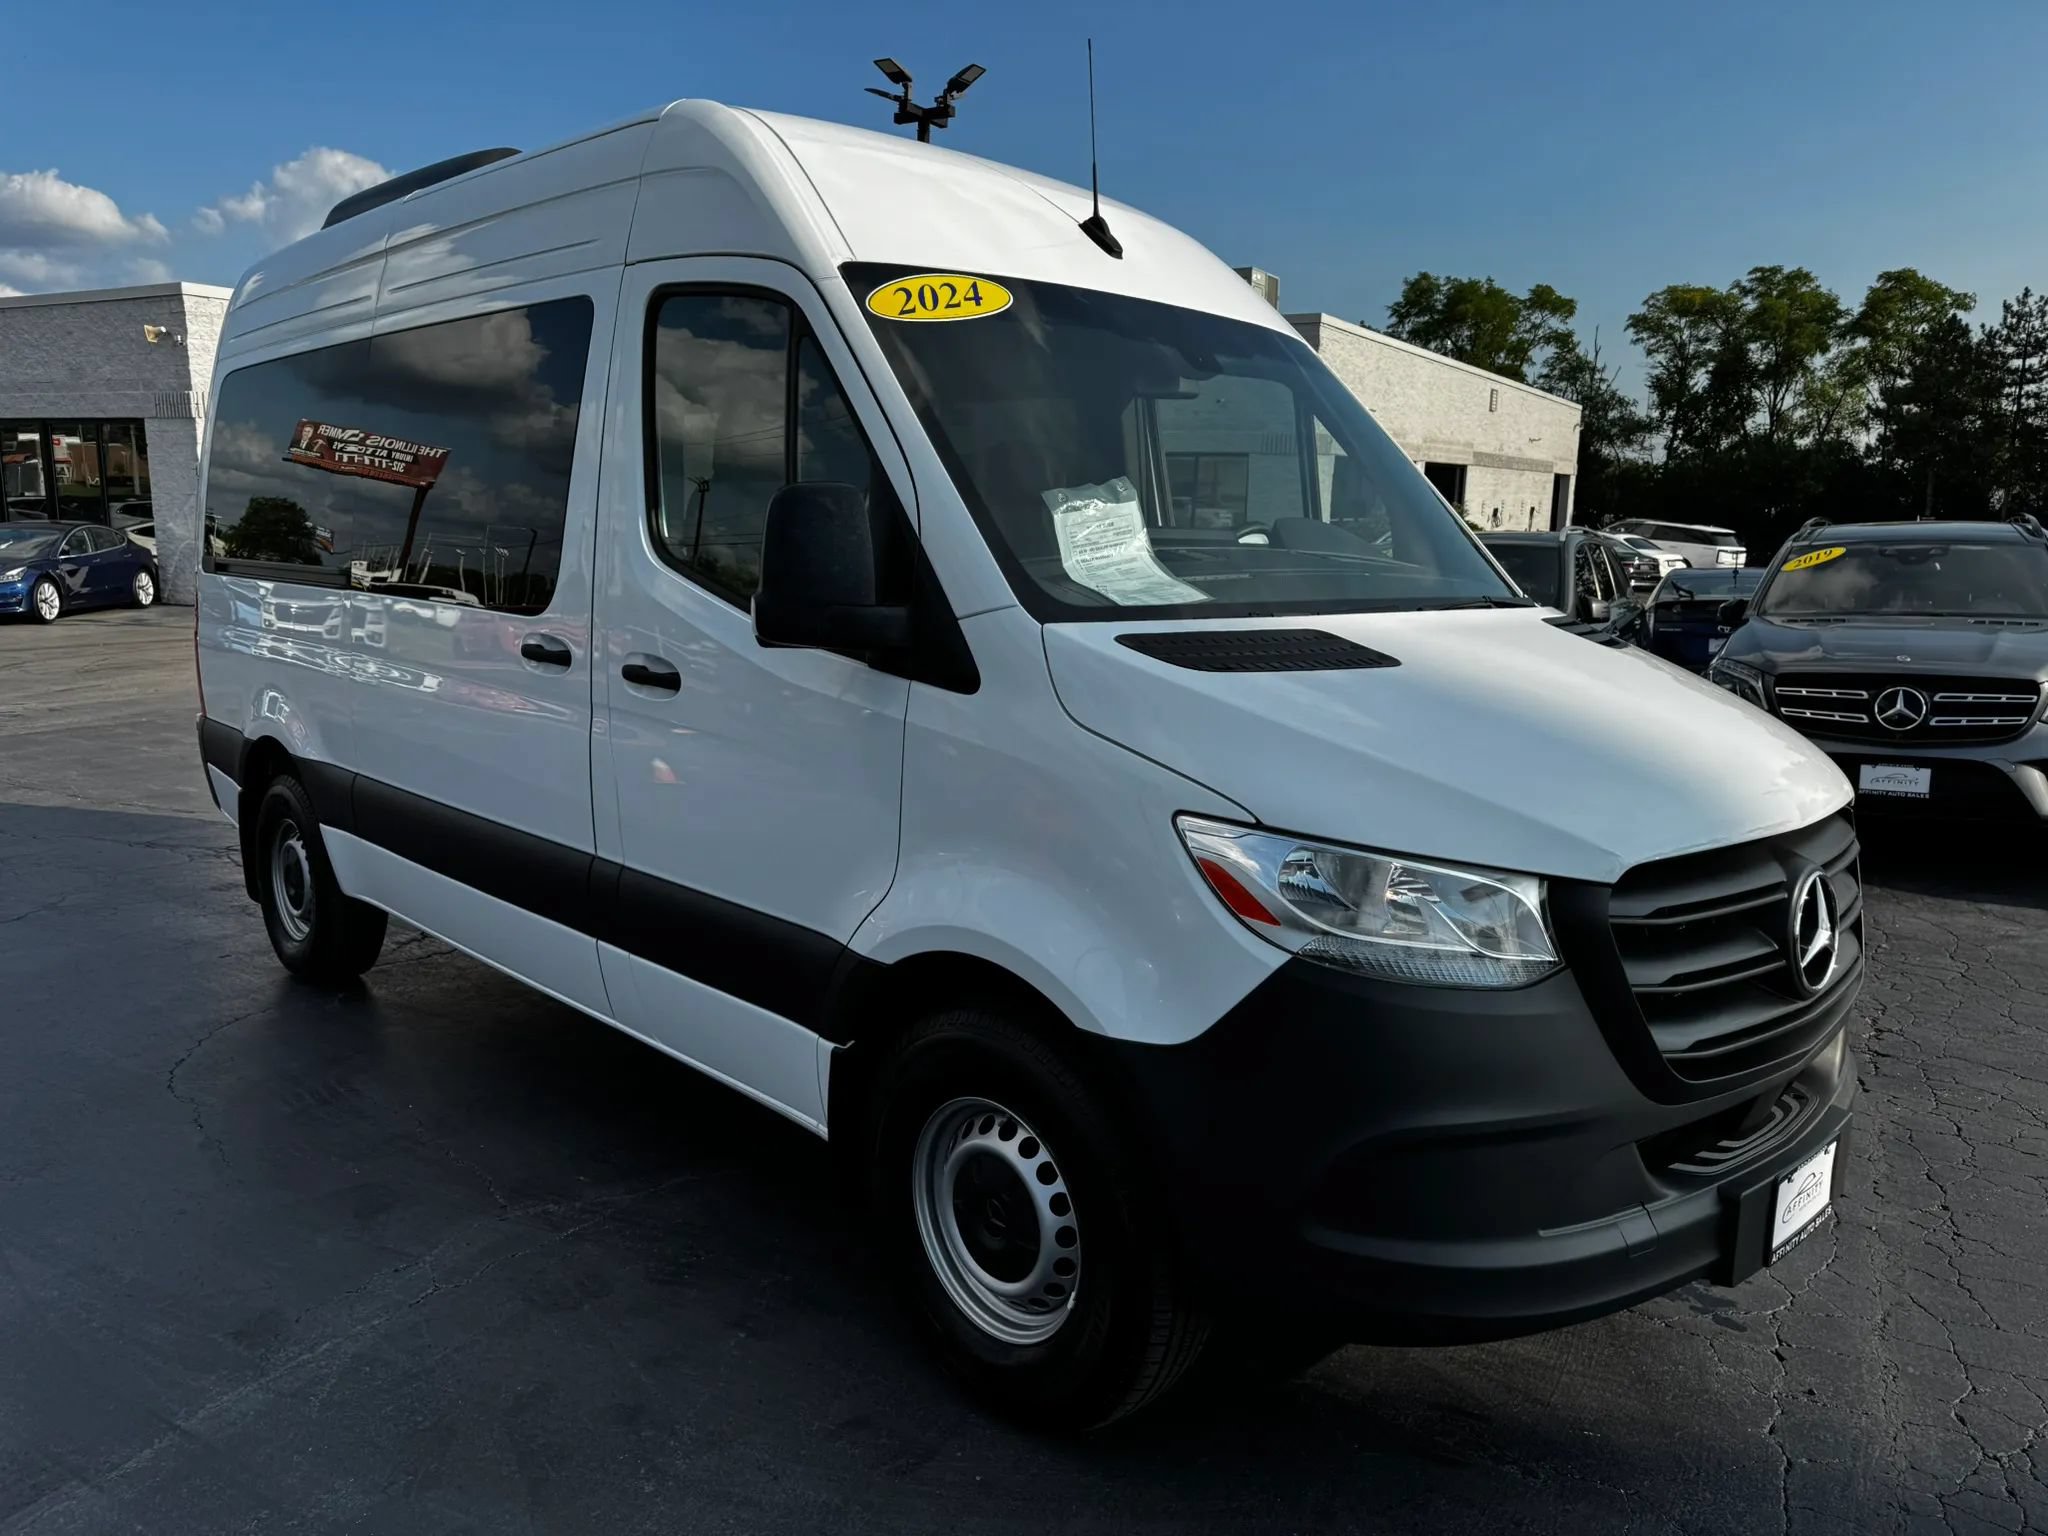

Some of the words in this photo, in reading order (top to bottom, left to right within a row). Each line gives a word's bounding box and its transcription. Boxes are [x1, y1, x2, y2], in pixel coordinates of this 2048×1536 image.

[893, 281, 983, 316] 2024
[1793, 550, 1833, 568] 2019
[1875, 778, 1920, 786] AFFINITY
[1786, 1180, 1823, 1218] AFFINITY
[1771, 1234, 1800, 1264] AFFINITY
[1800, 1221, 1815, 1242] AUTO
[1815, 1204, 1832, 1228] SALES
